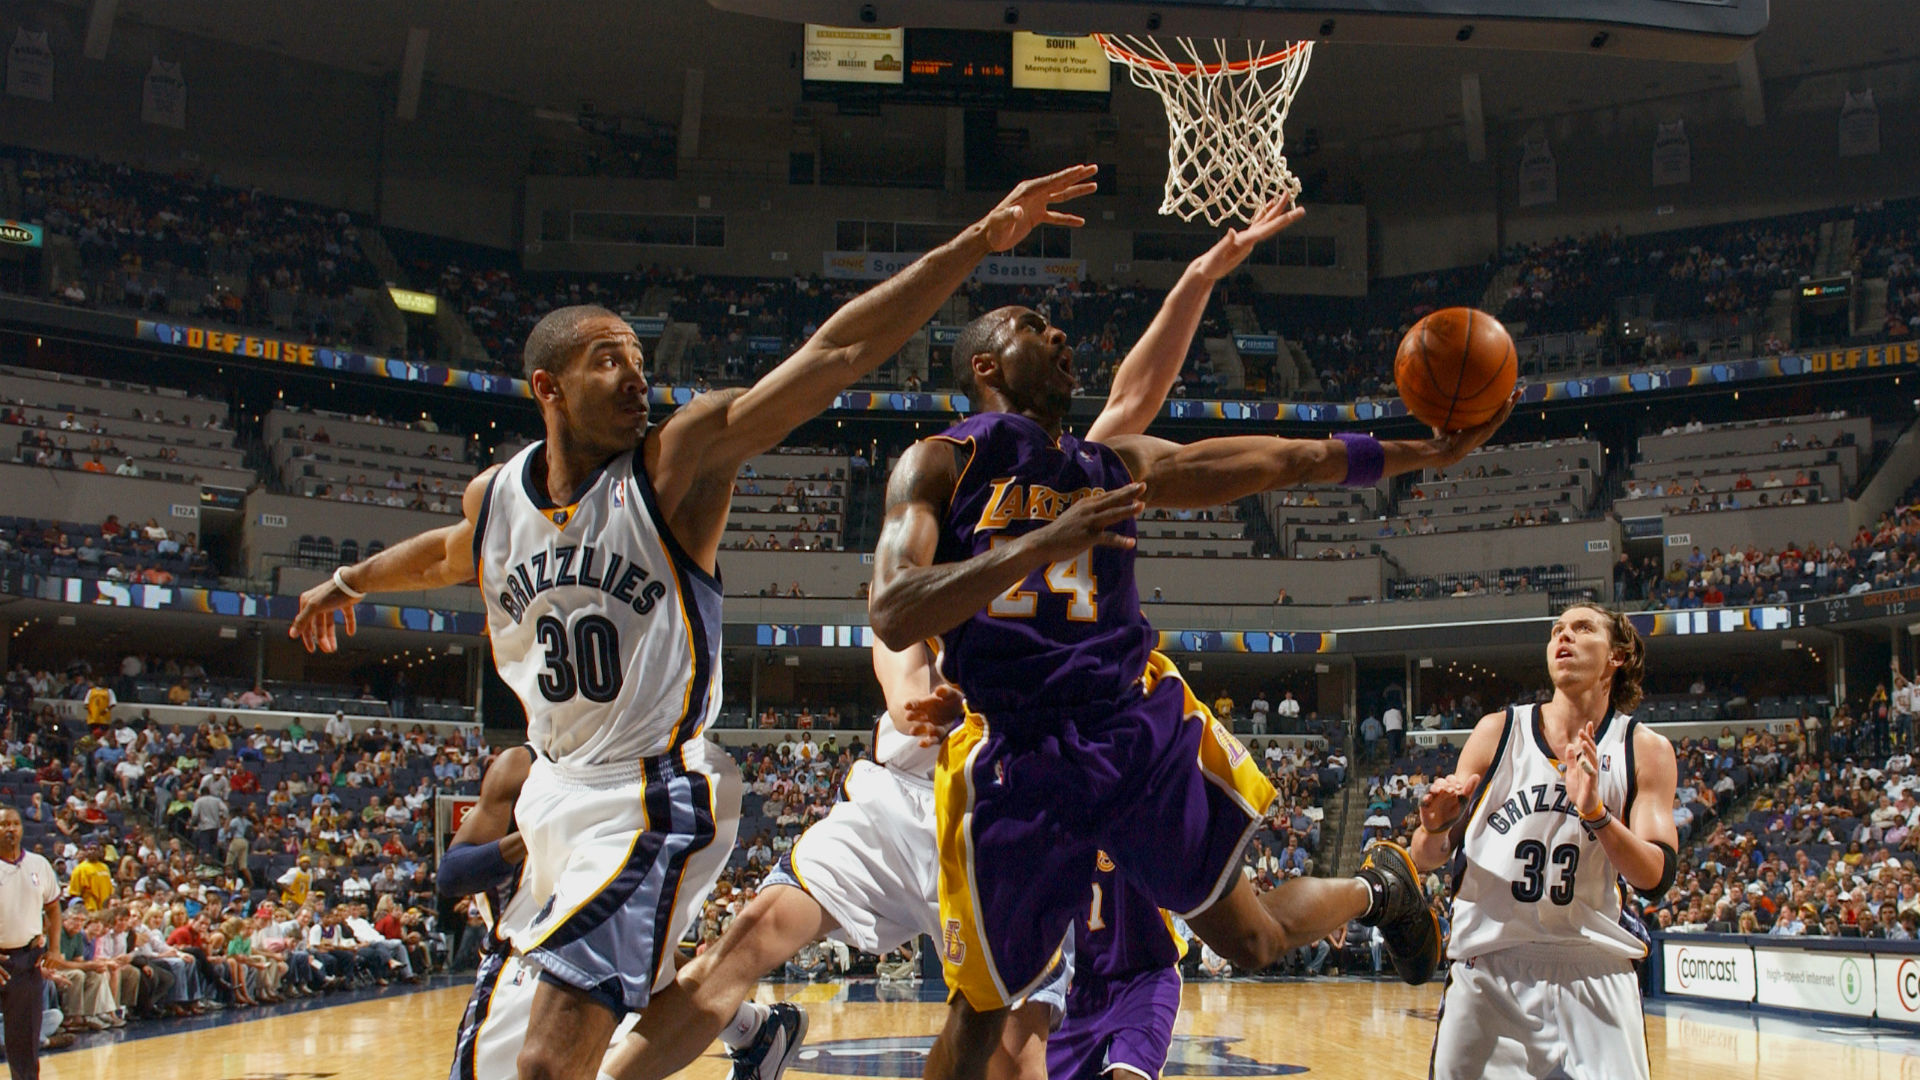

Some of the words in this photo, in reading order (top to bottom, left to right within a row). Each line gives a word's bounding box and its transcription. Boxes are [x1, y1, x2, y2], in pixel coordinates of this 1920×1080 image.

[1046, 38, 1076, 49] SOUTH
[1034, 55, 1058, 63] Home
[1059, 56, 1068, 64] of
[1070, 57, 1088, 65] Your
[1025, 63, 1061, 73] Memphis
[1063, 65, 1097, 74] Grizzlies
[989, 263, 1037, 277] Seats
[187, 326, 318, 367] DEFENSE
[1669, 534, 1689, 545] 107A
[499, 545, 666, 625] GRIZZLIES
[1885, 602, 1906, 616] 112
[536, 614, 624, 703] 30
[1511, 839, 1580, 906] 33
[1681, 955, 1737, 983] comcast
[1766, 968, 1806, 985] high-speed
[1806, 970, 1836, 987] internet
